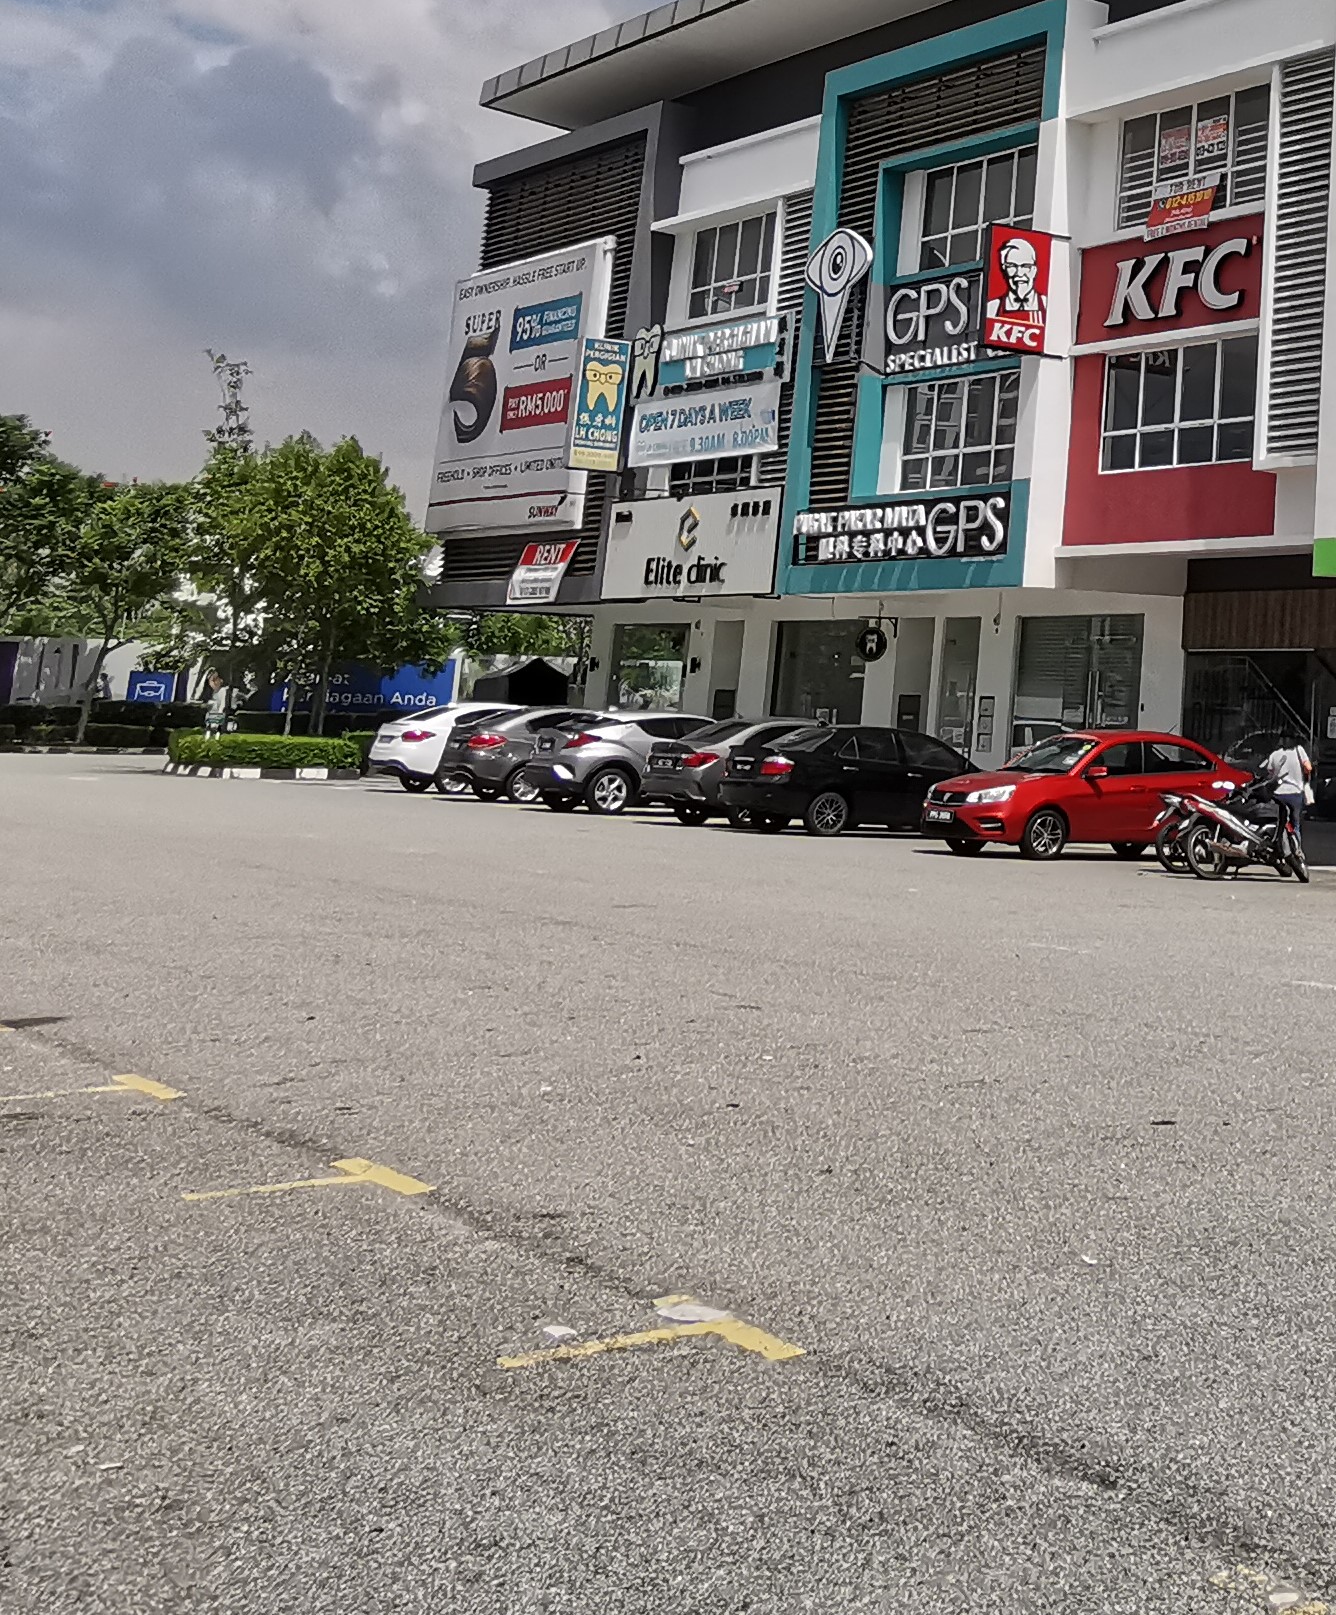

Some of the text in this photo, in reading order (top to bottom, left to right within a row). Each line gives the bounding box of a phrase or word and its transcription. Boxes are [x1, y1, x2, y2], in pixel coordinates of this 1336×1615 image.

[459, 288, 473, 301] EASY
[537, 265, 554, 281] FREE
[1103, 238, 1249, 327] KFC
[465, 310, 501, 335] SUPER
[886, 276, 969, 345] GPS
[989, 322, 1041, 347] KFC
[534, 354, 547, 371] OR
[886, 341, 978, 373] SPECIALIST
[639, 411, 667, 433] OPEN
[677, 405, 706, 428] DAYS
[707, 403, 717, 424] A
[718, 397, 752, 422] WEEK
[575, 426, 618, 443] LH CHONG
[528, 505, 560, 519] SUNWAY
[926, 497, 1005, 556] GPS
[532, 544, 567, 565] RENT
[644, 556, 683, 585] Elite
[390, 691, 437, 706] Anda
